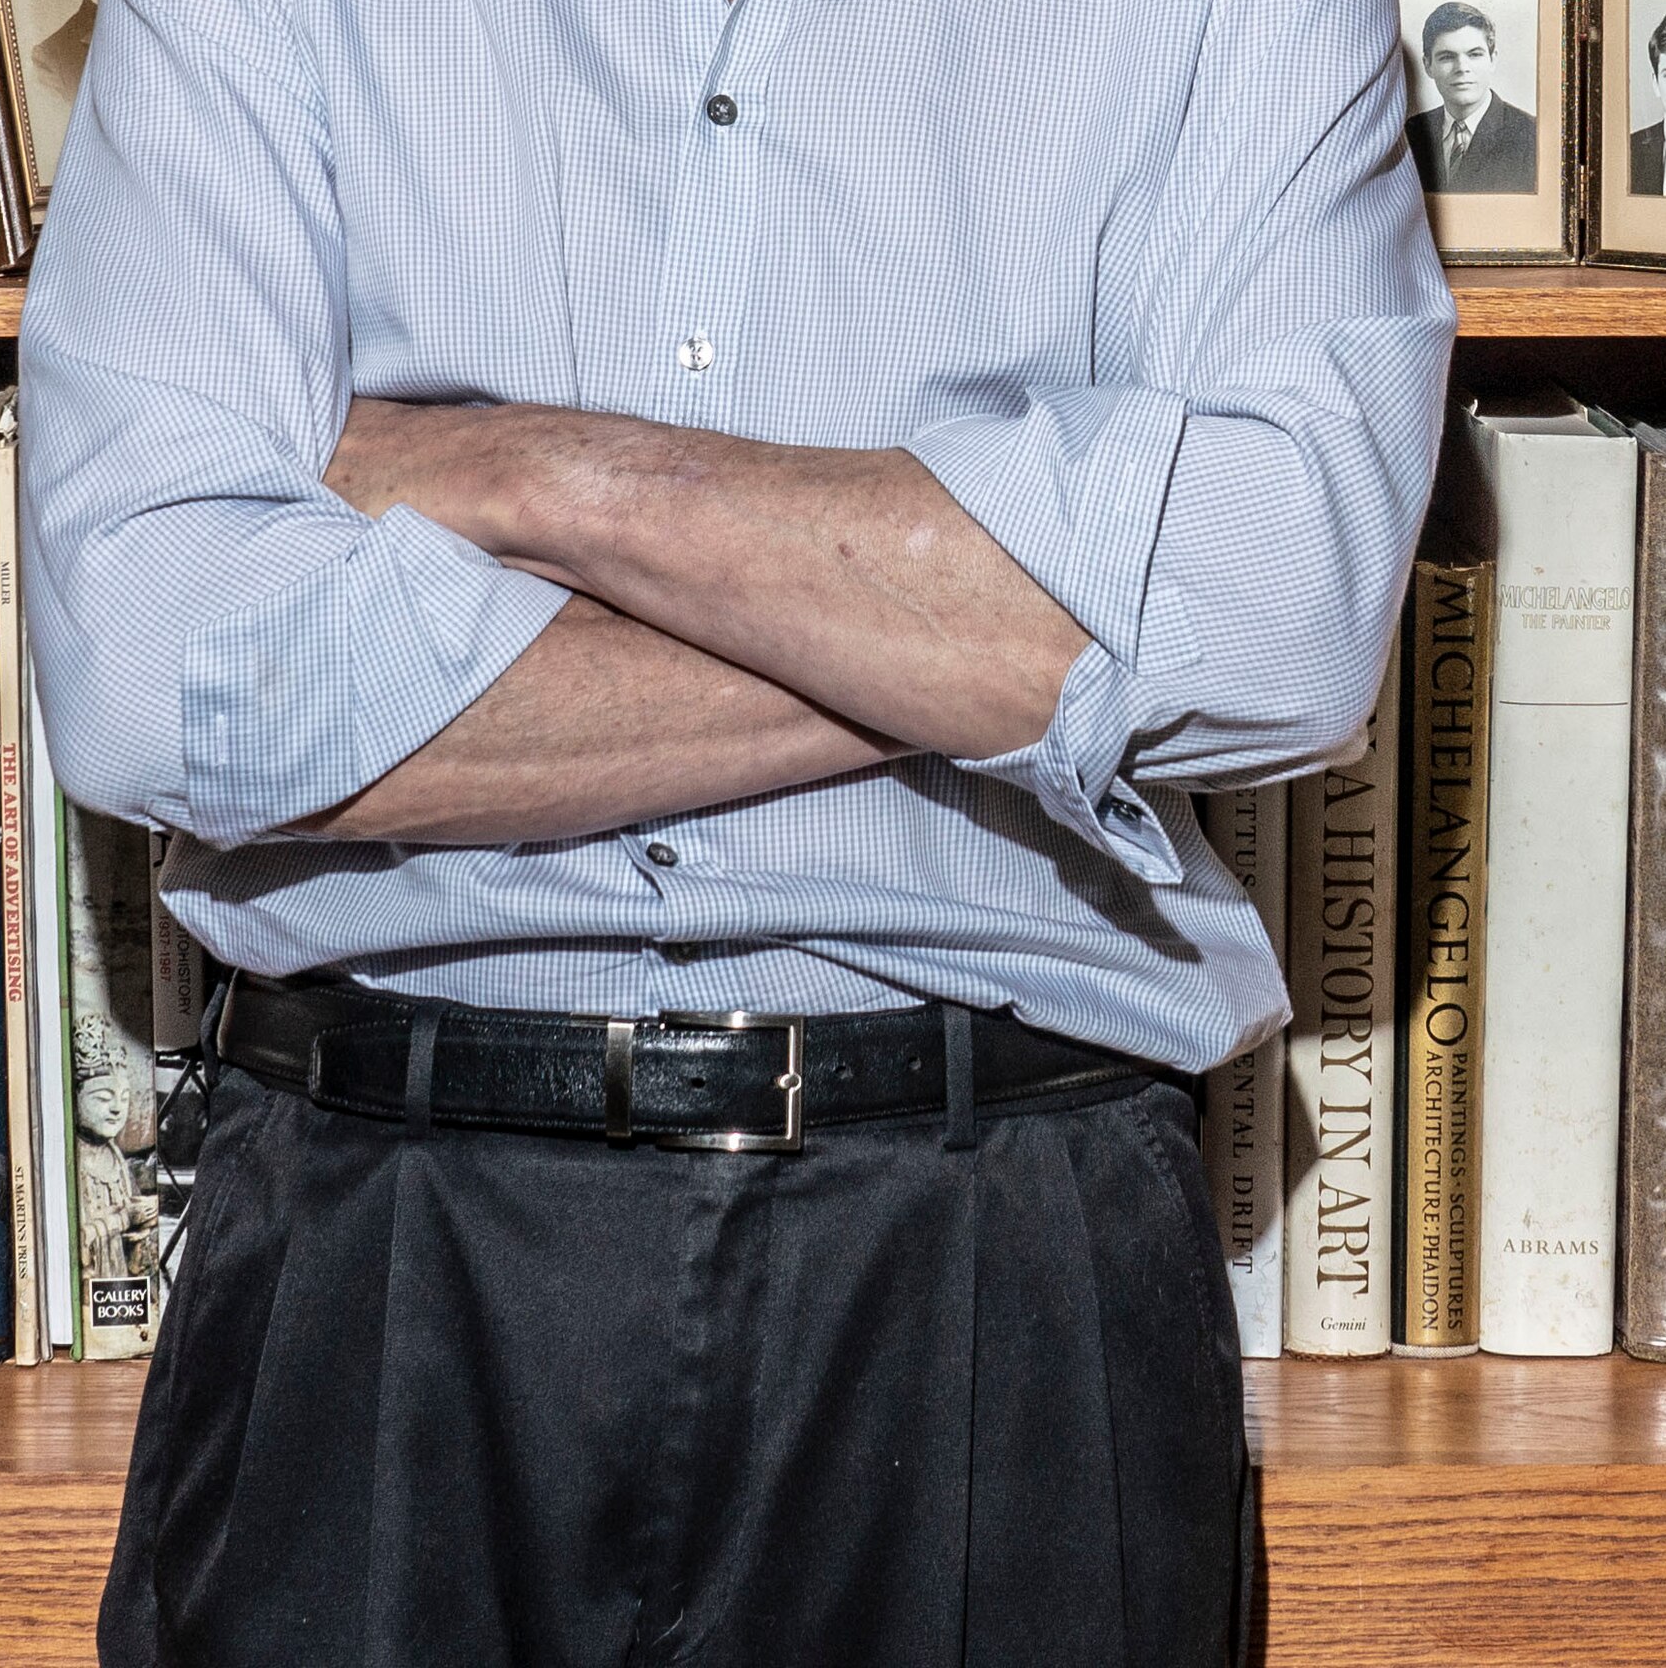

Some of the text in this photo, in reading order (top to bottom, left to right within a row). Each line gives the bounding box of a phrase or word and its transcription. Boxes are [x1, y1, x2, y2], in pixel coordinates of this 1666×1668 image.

[1425, 575, 1473, 1047] MICHELANGELO
[2, 743, 22, 1002] THE ART OF ADVERTISING
[1317, 771, 1375, 1298] A HISTORY IN ART
[1504, 1239, 1598, 1254] ABRAMS
[94, 1289, 147, 1303] GALLERY
[97, 1303, 145, 1318] BOOKS
[1321, 1318, 1365, 1330] Gemini
